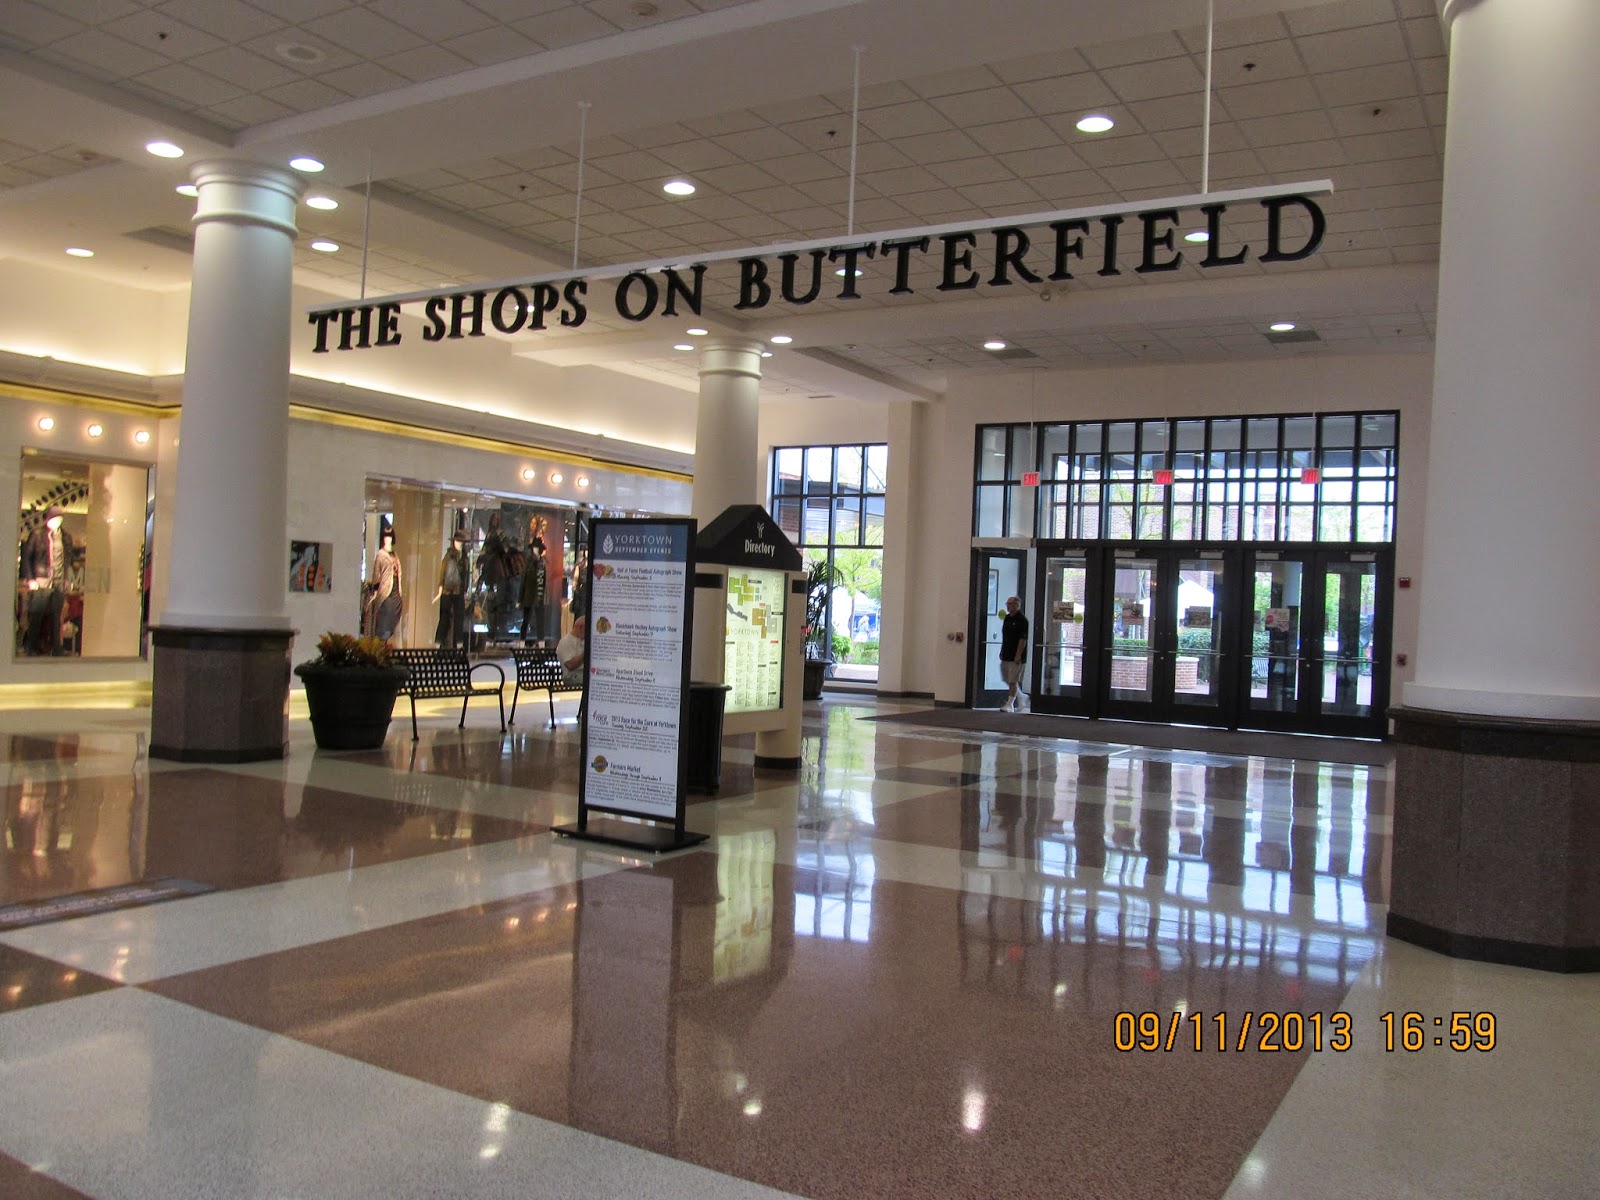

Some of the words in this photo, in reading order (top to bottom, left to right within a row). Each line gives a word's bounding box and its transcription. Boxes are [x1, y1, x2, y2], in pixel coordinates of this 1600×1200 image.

[308, 302, 401, 354] THE
[423, 278, 588, 342] SHOPS
[615, 264, 708, 322] ON
[733, 194, 1326, 310] BUTTERFIELD
[614, 534, 672, 545] YORKTOWN
[744, 538, 775, 558] Directory
